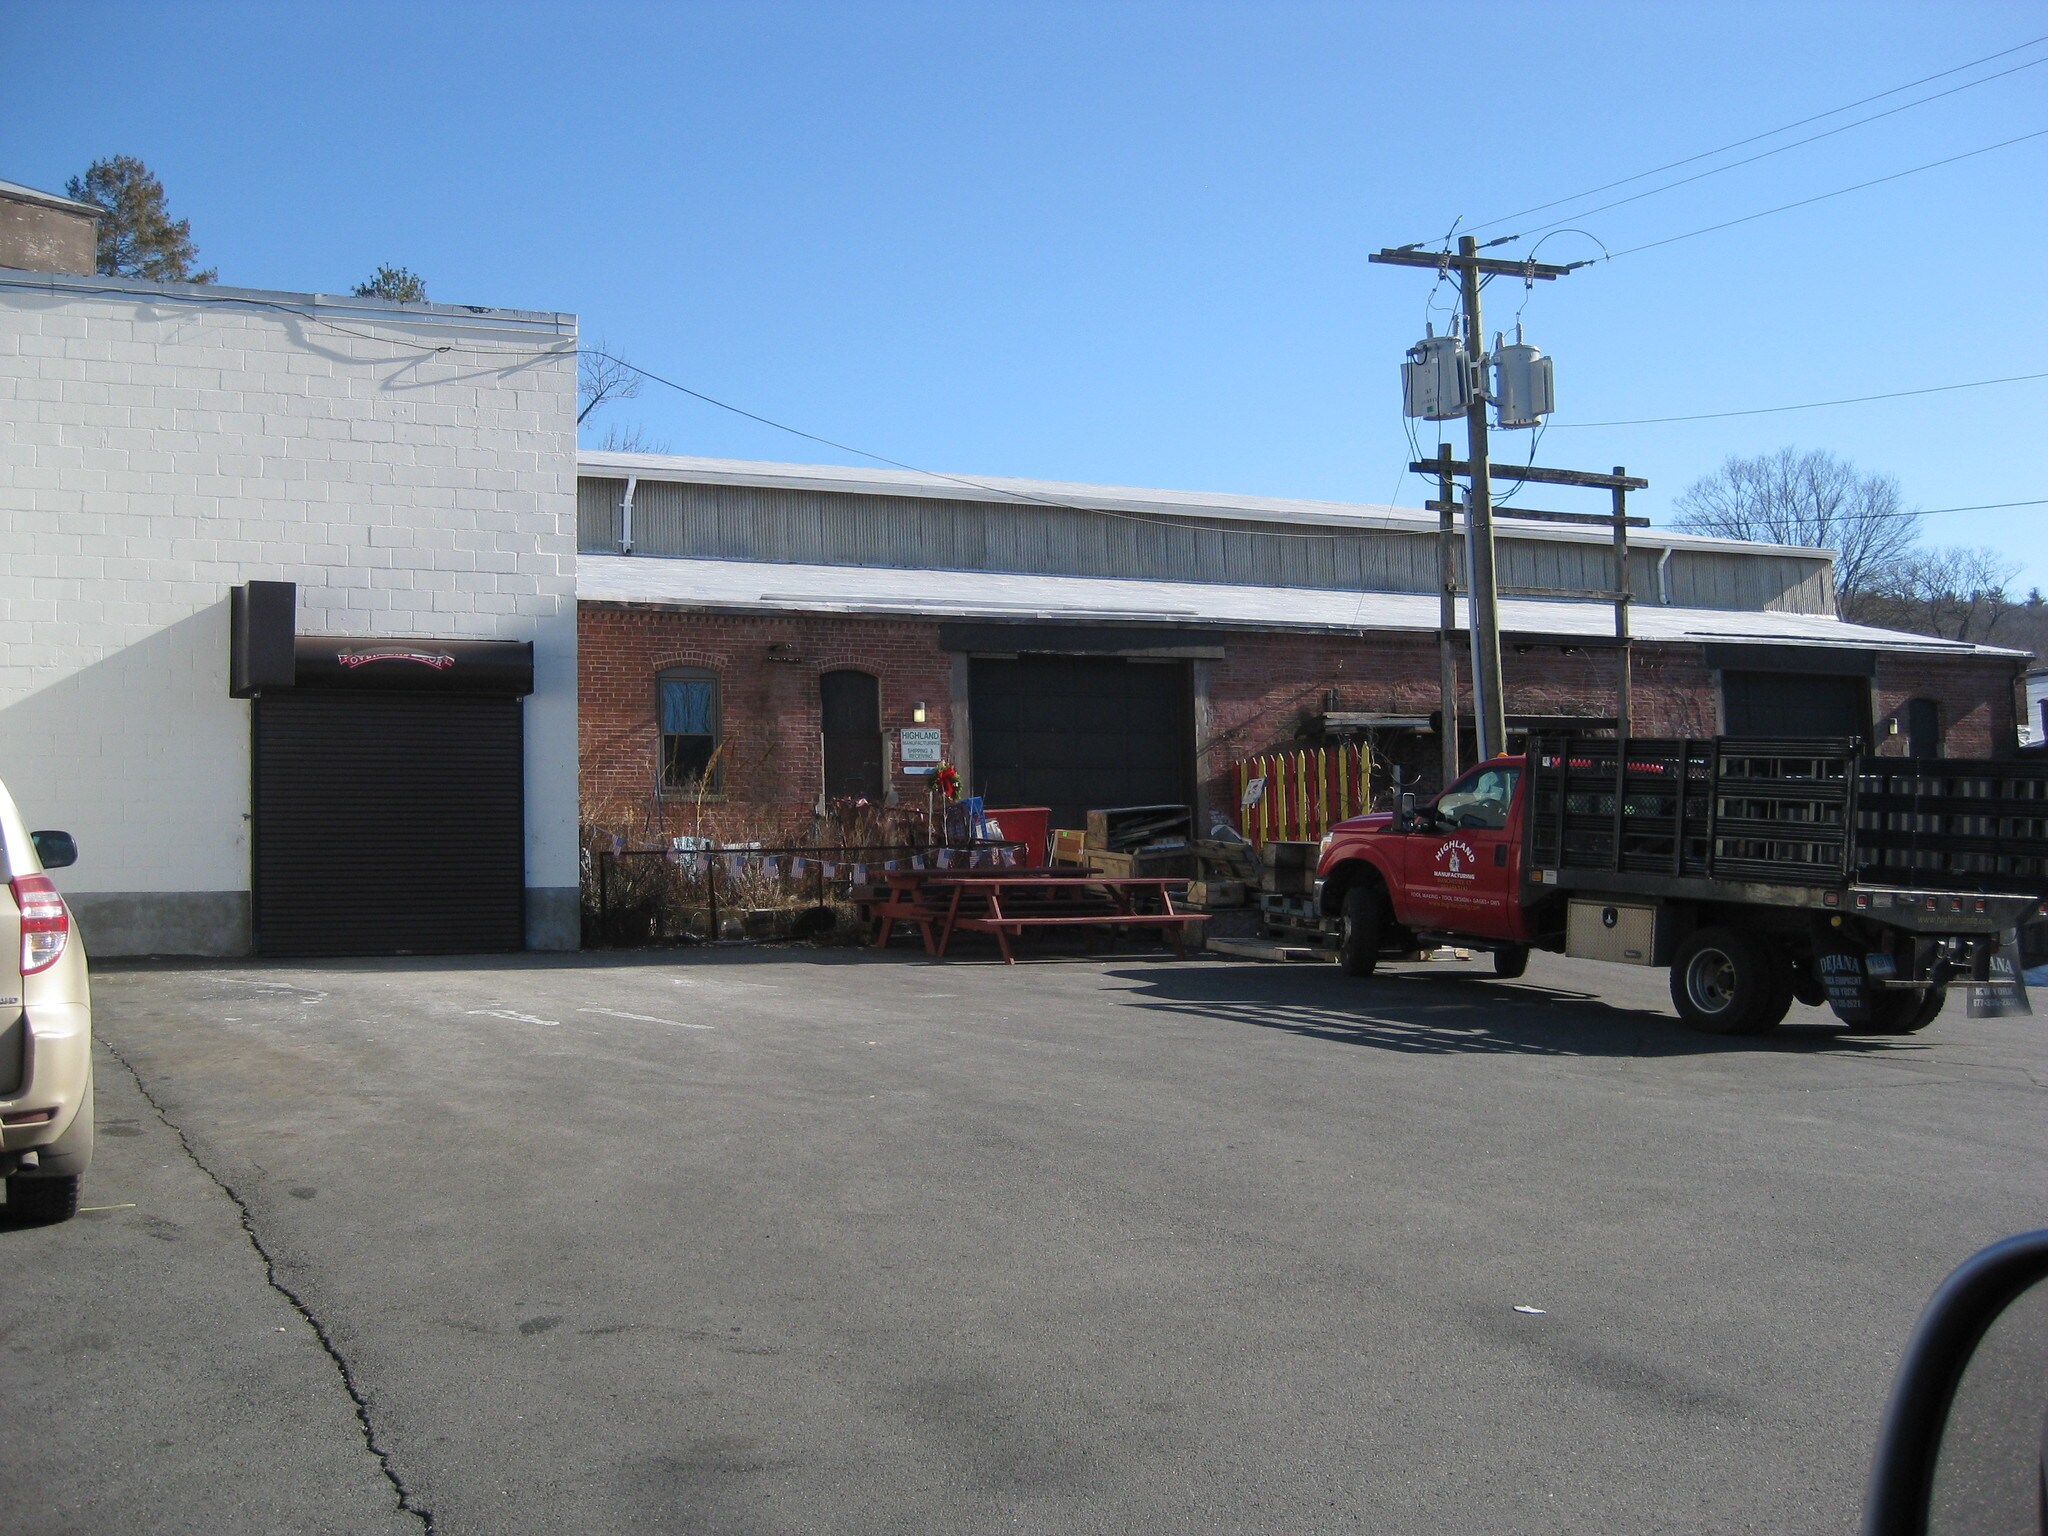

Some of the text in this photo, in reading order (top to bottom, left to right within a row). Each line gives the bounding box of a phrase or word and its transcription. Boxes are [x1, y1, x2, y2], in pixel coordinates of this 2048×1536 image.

[902, 731, 939, 740] HIGHLAND
[1435, 840, 1475, 863] HIGHLAND
[1433, 870, 1475, 880] MANUFACTURING
[1820, 955, 1860, 974] DEJANA
[1990, 956, 2014, 975] ANA
